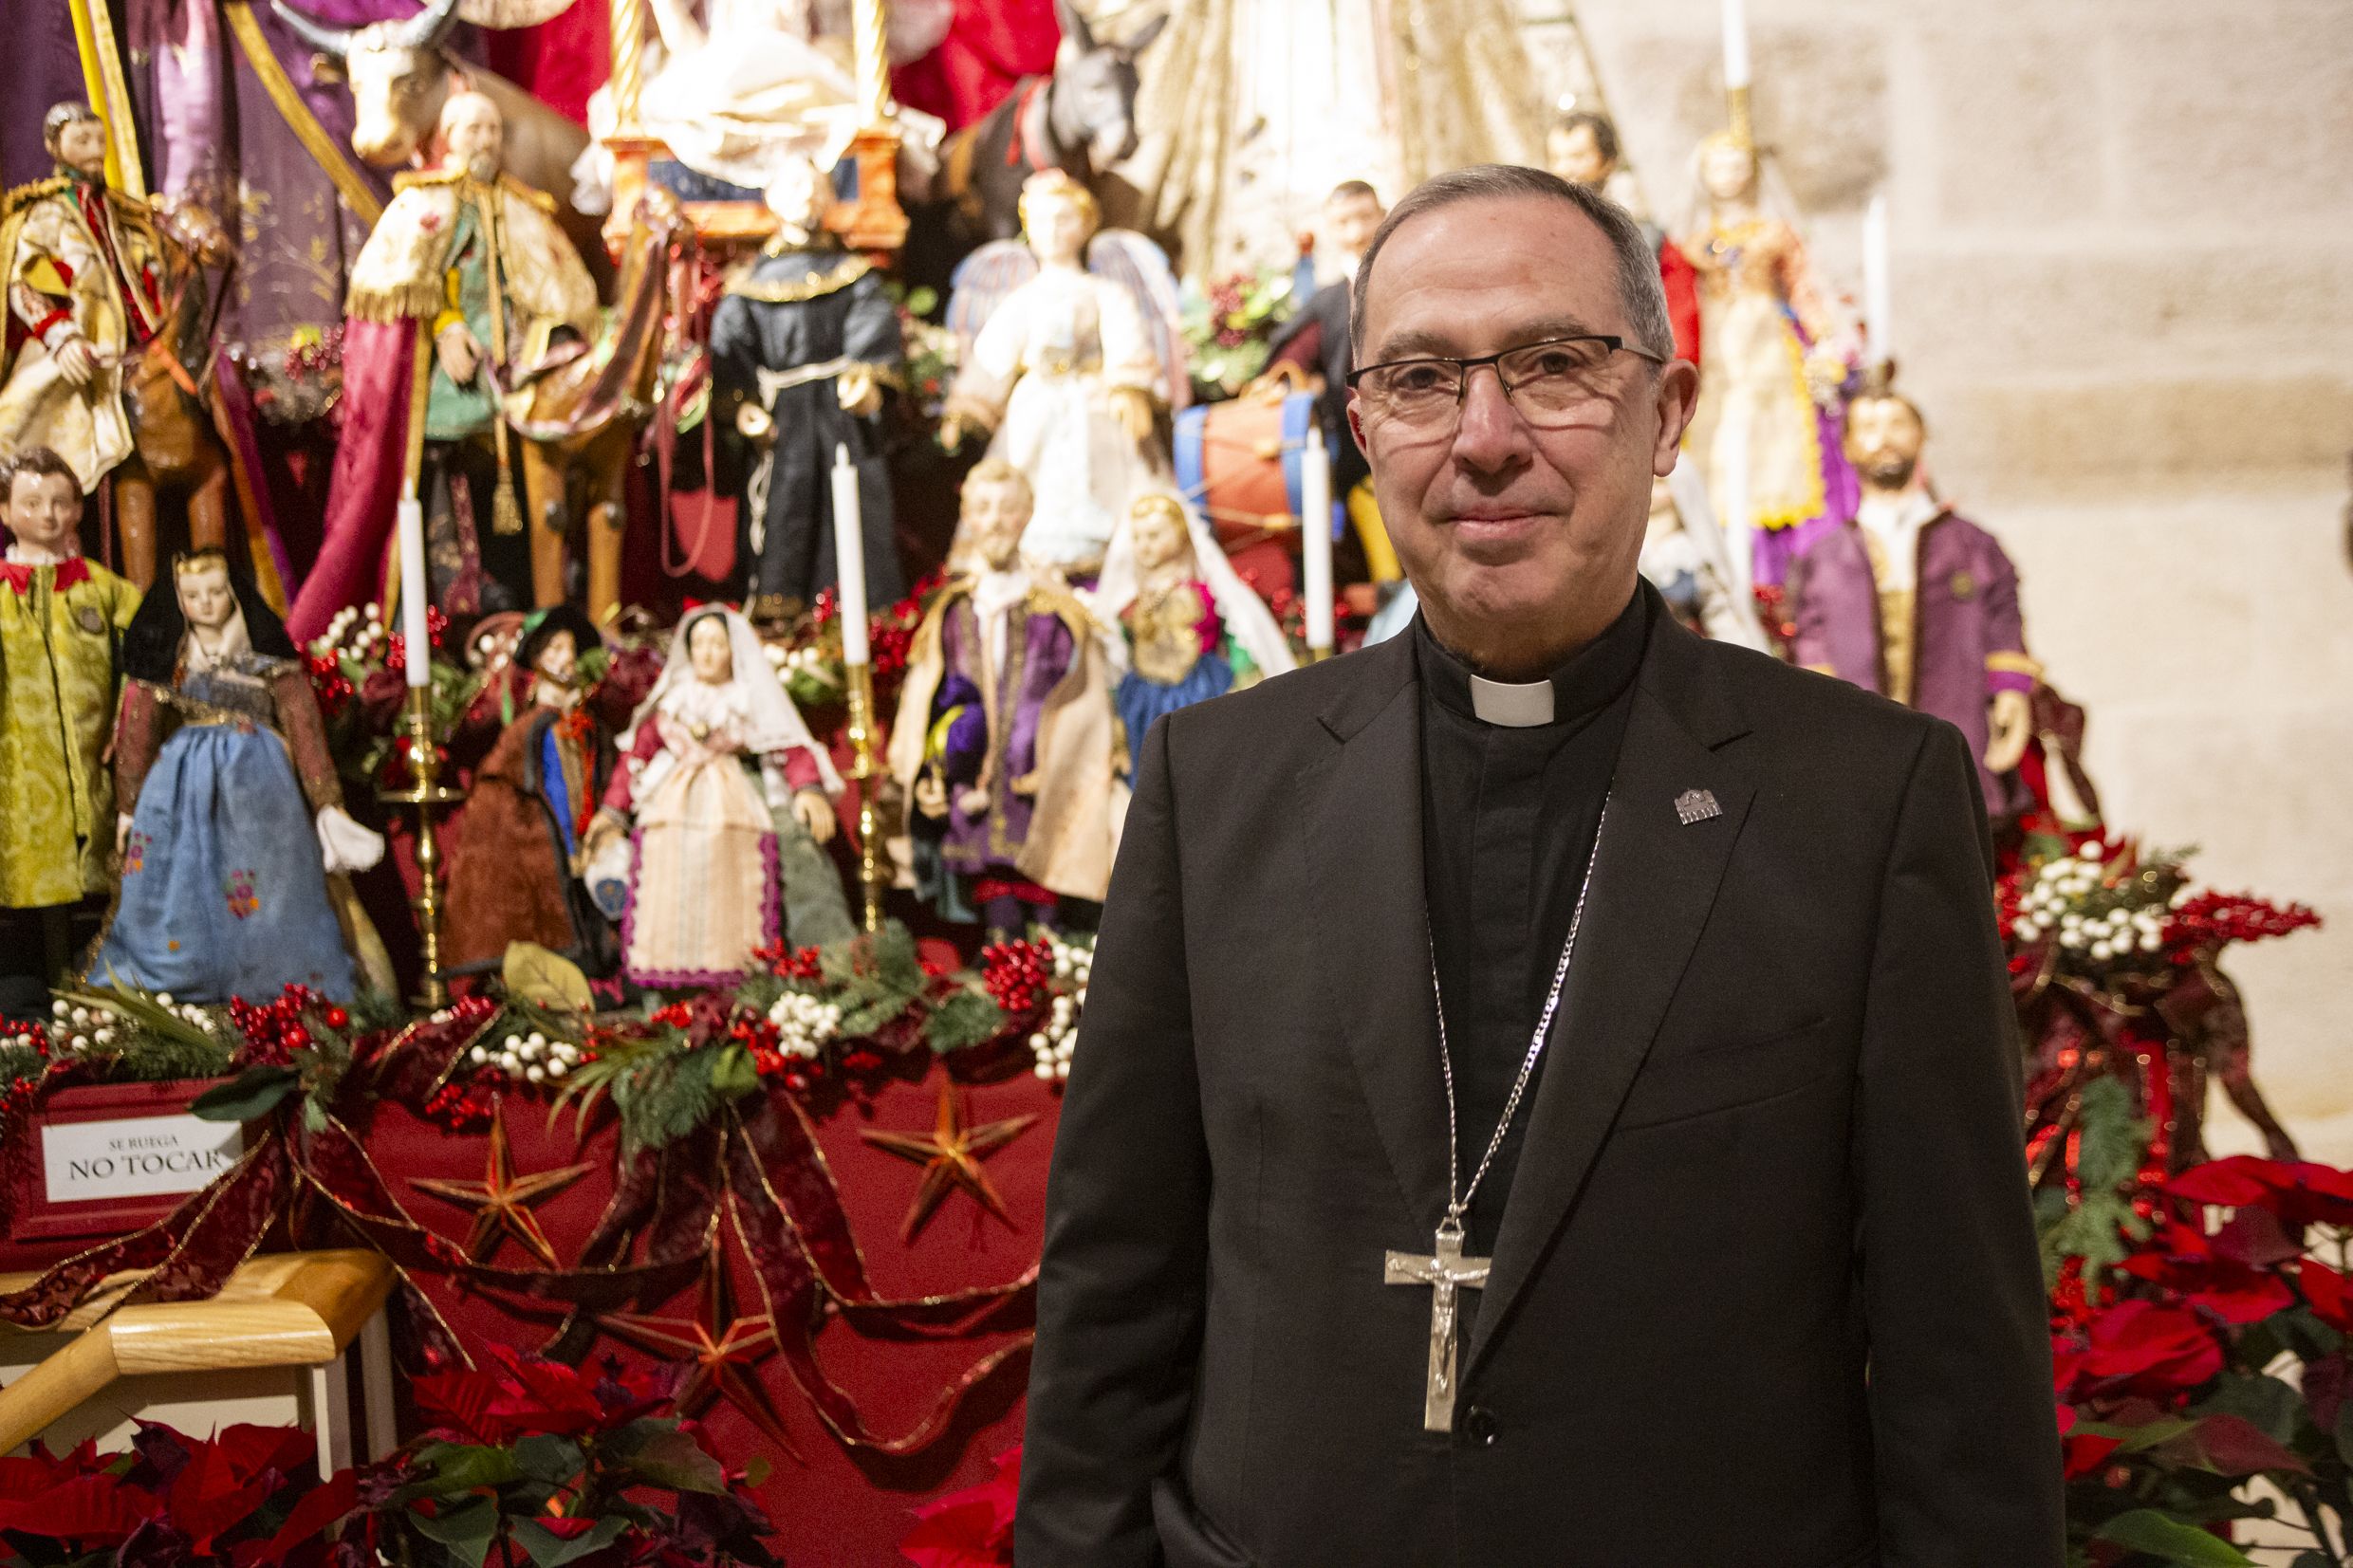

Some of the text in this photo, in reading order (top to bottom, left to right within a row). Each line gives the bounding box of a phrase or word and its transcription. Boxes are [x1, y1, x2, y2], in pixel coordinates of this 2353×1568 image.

[109, 1134, 178, 1151] SE RUEGA
[69, 1149, 223, 1180] NO TOCAR
